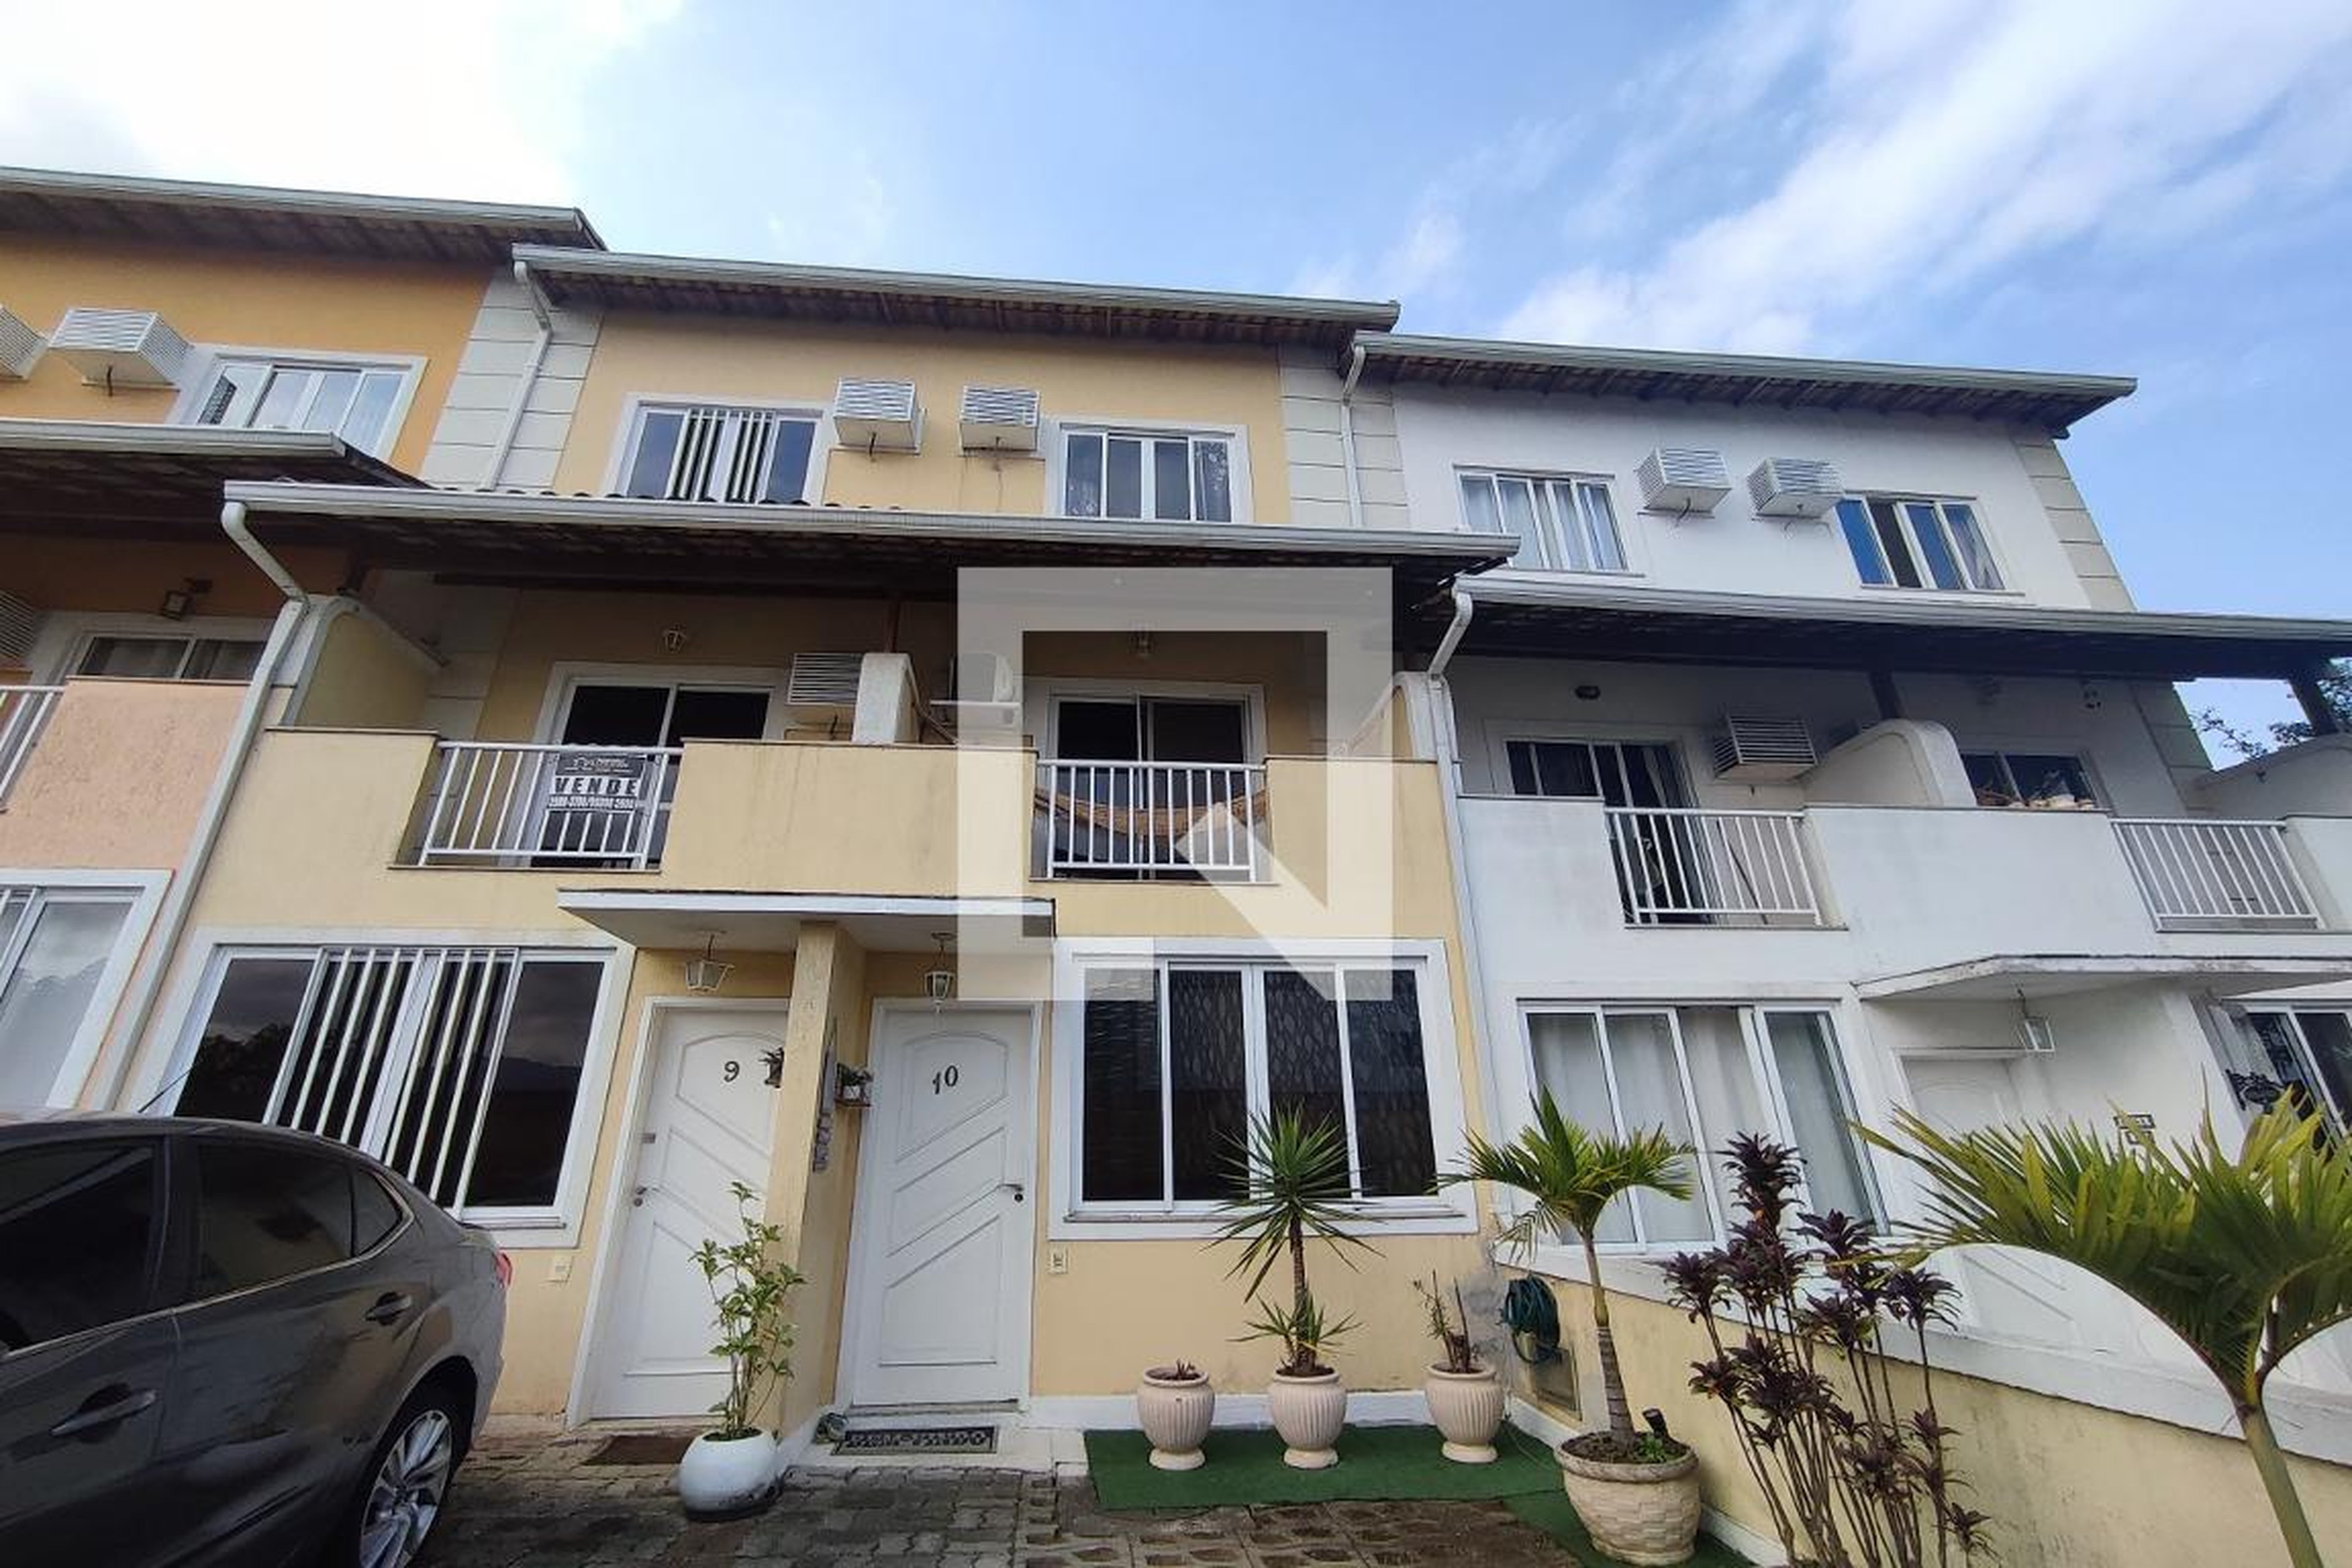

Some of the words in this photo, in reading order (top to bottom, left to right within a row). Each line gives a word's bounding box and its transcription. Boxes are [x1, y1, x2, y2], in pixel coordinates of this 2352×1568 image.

[555, 777, 638, 794] VENDE
[723, 1060, 740, 1083] 9
[932, 1065, 959, 1095] 10
